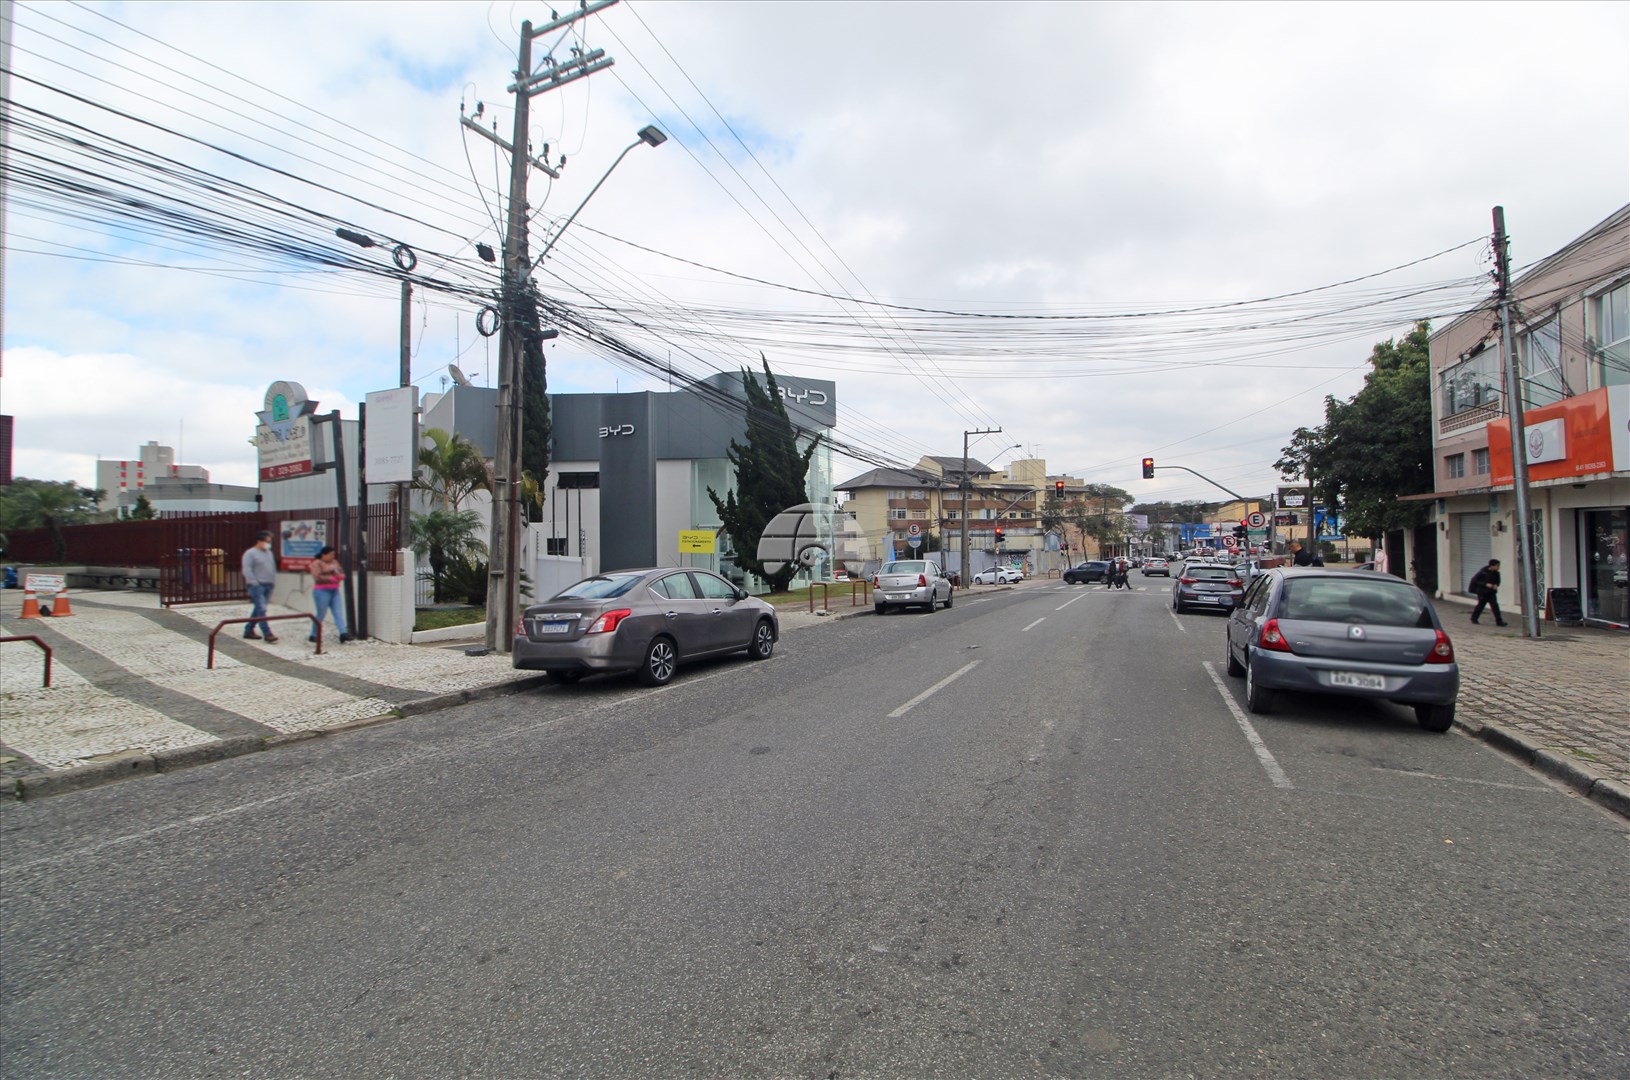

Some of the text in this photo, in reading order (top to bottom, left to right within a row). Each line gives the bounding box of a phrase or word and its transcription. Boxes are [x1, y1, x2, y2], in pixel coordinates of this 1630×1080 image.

[599, 424, 635, 438] BYD
[1253, 515, 1260, 525] E
[911, 525, 917, 533] E
